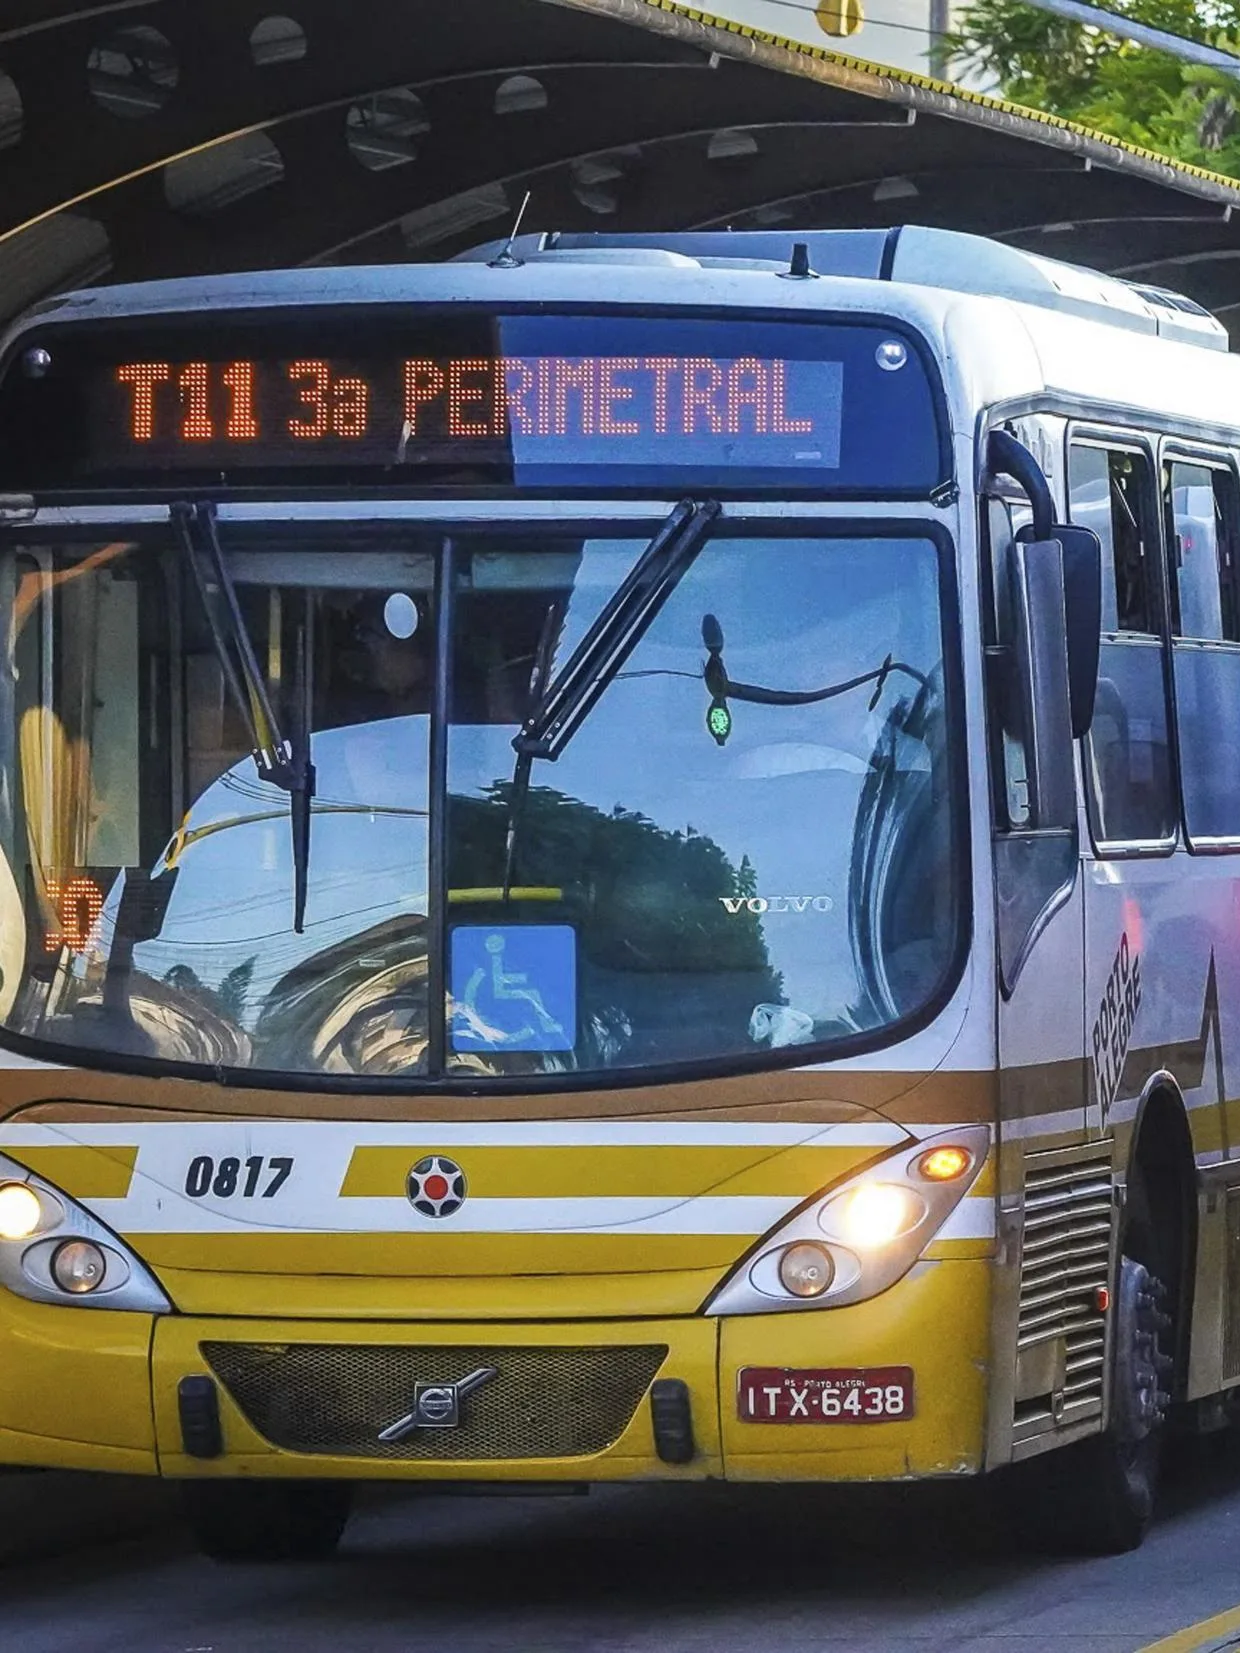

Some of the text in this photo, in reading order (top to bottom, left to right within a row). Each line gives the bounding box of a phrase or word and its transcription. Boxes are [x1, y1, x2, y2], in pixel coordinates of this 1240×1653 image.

[118, 357, 813, 439] T11 3a PERIMETRAL
[718, 896, 832, 914] VOLVO
[1092, 931, 1129, 1079] PORTO
[1100, 953, 1141, 1131] ALEGRE
[185, 1155, 294, 1198] 0817
